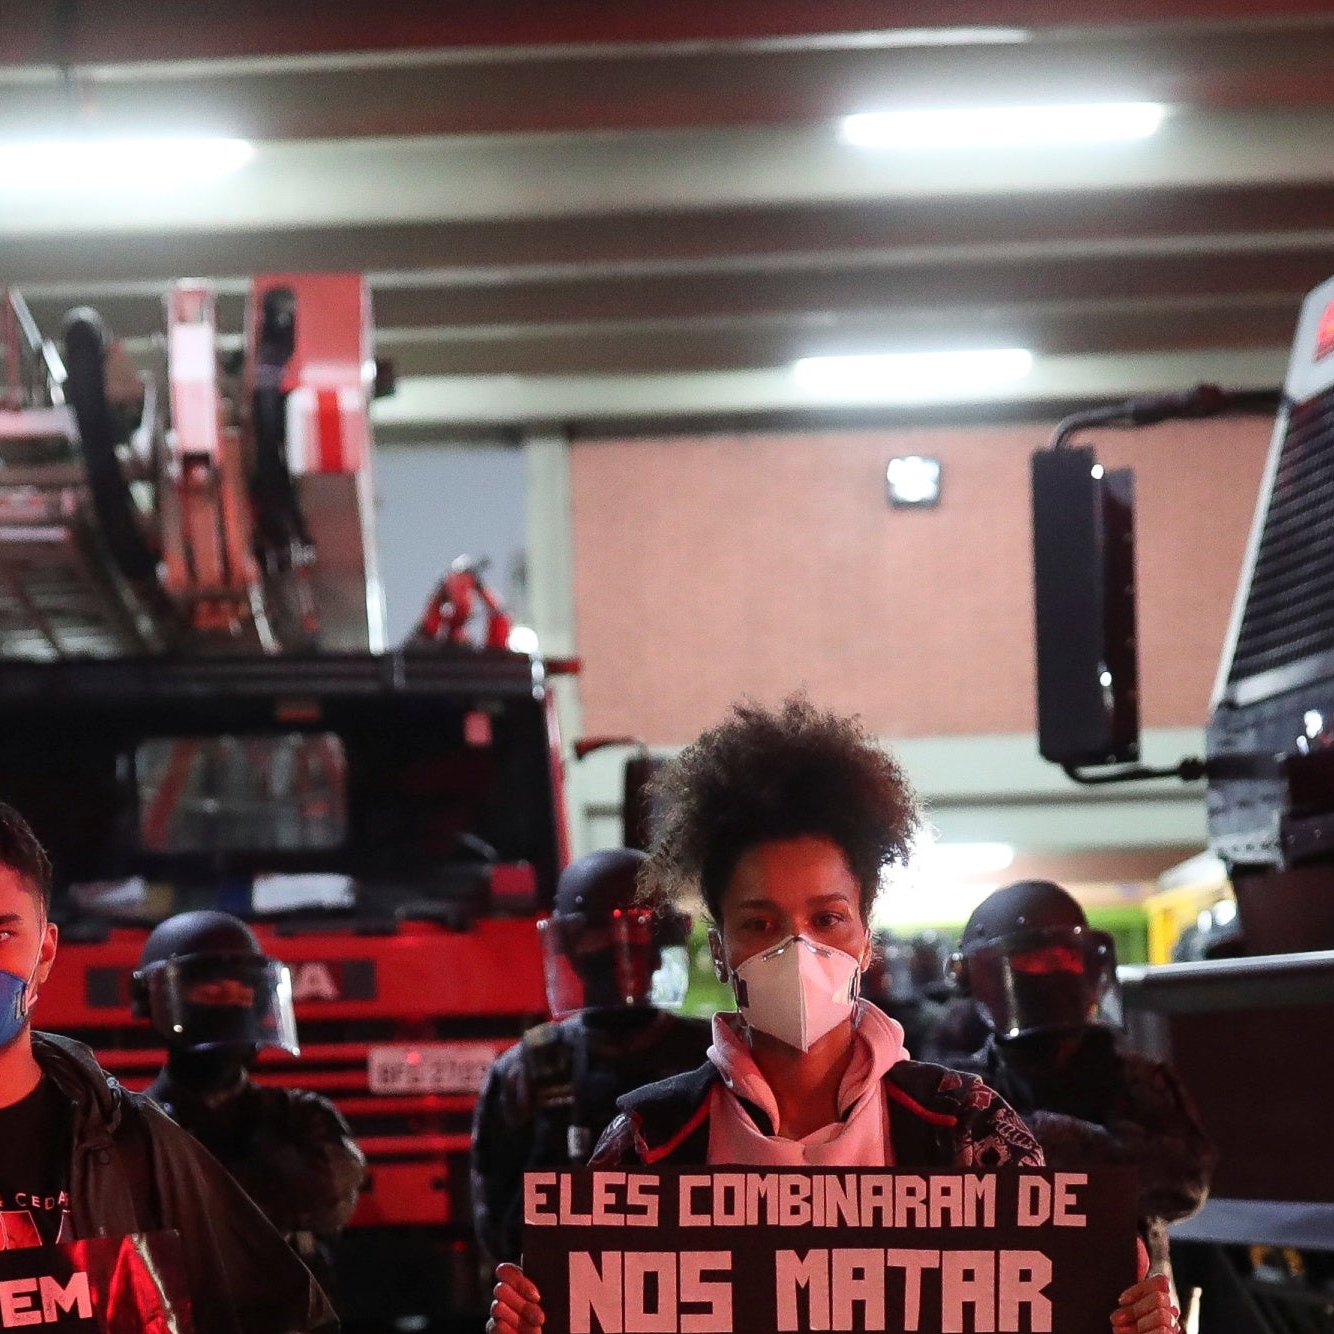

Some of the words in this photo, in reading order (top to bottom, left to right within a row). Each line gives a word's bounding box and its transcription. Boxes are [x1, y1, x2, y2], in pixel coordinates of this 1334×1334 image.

[524, 1172, 659, 1226] ELES
[679, 1173, 996, 1227] COMBINARAM
[1017, 1173, 1088, 1227] DE
[569, 1251, 733, 1334] NOS
[776, 1248, 1053, 1333] MATAR
